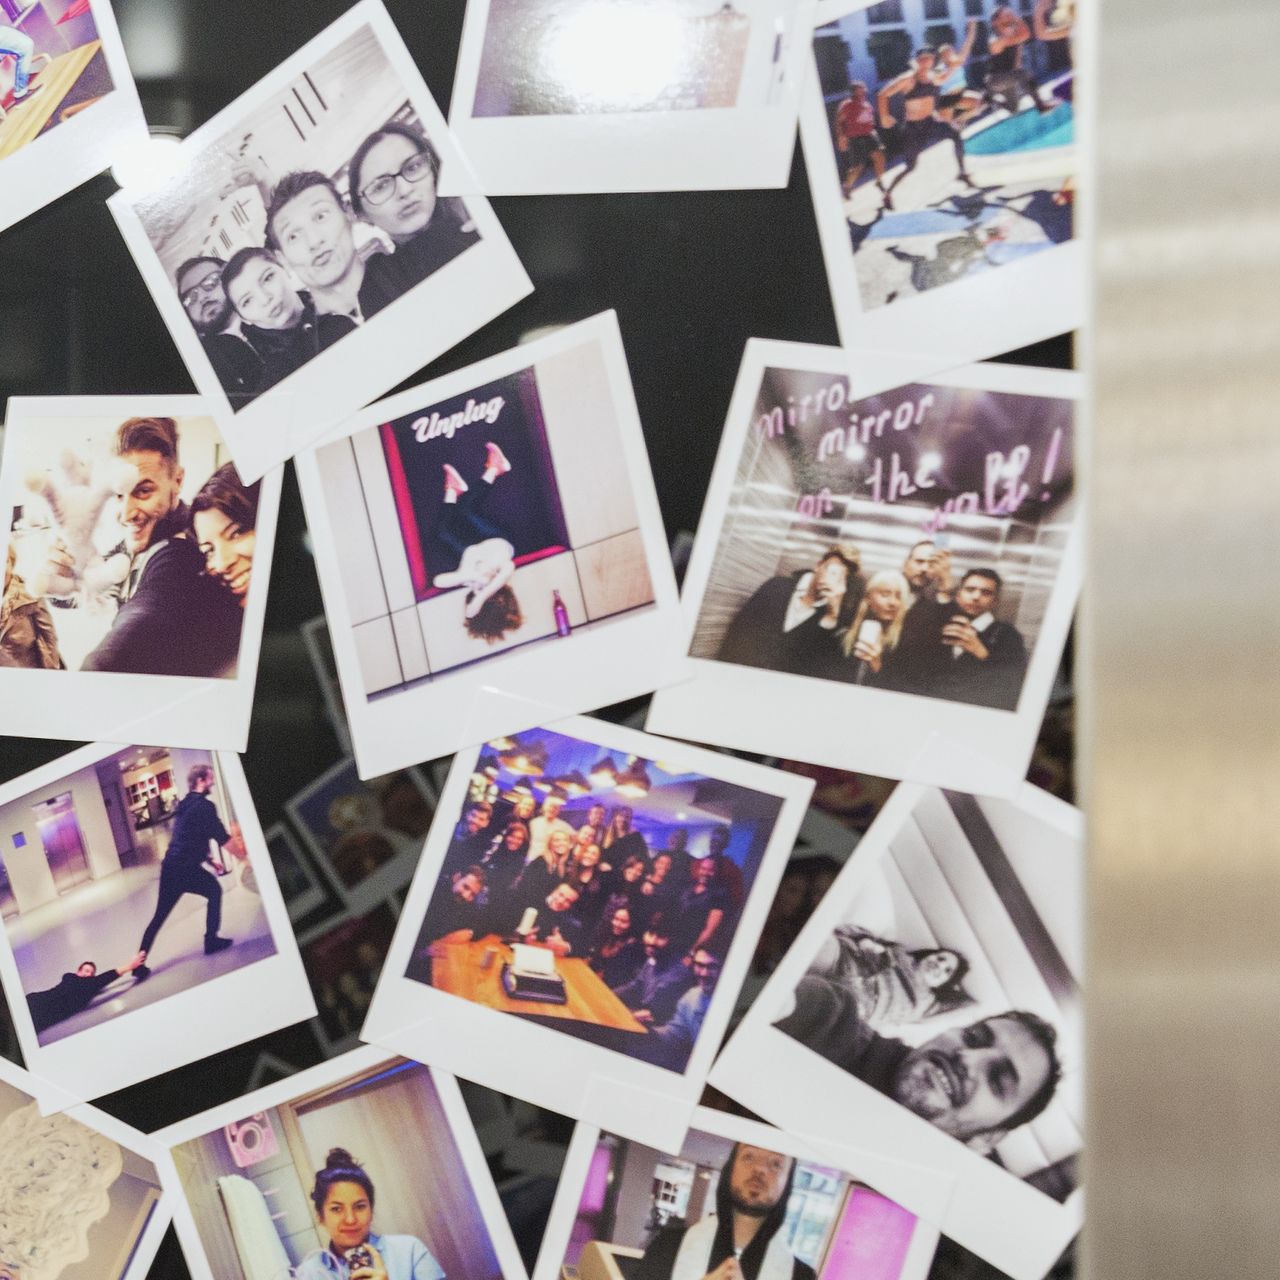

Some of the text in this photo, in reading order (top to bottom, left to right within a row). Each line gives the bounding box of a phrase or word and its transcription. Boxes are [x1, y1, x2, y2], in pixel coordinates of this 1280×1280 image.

[411, 395, 506, 443] Unplug
[755, 382, 851, 439] mirro
[818, 393, 934, 461] mirror
[798, 451, 937, 521] on the
